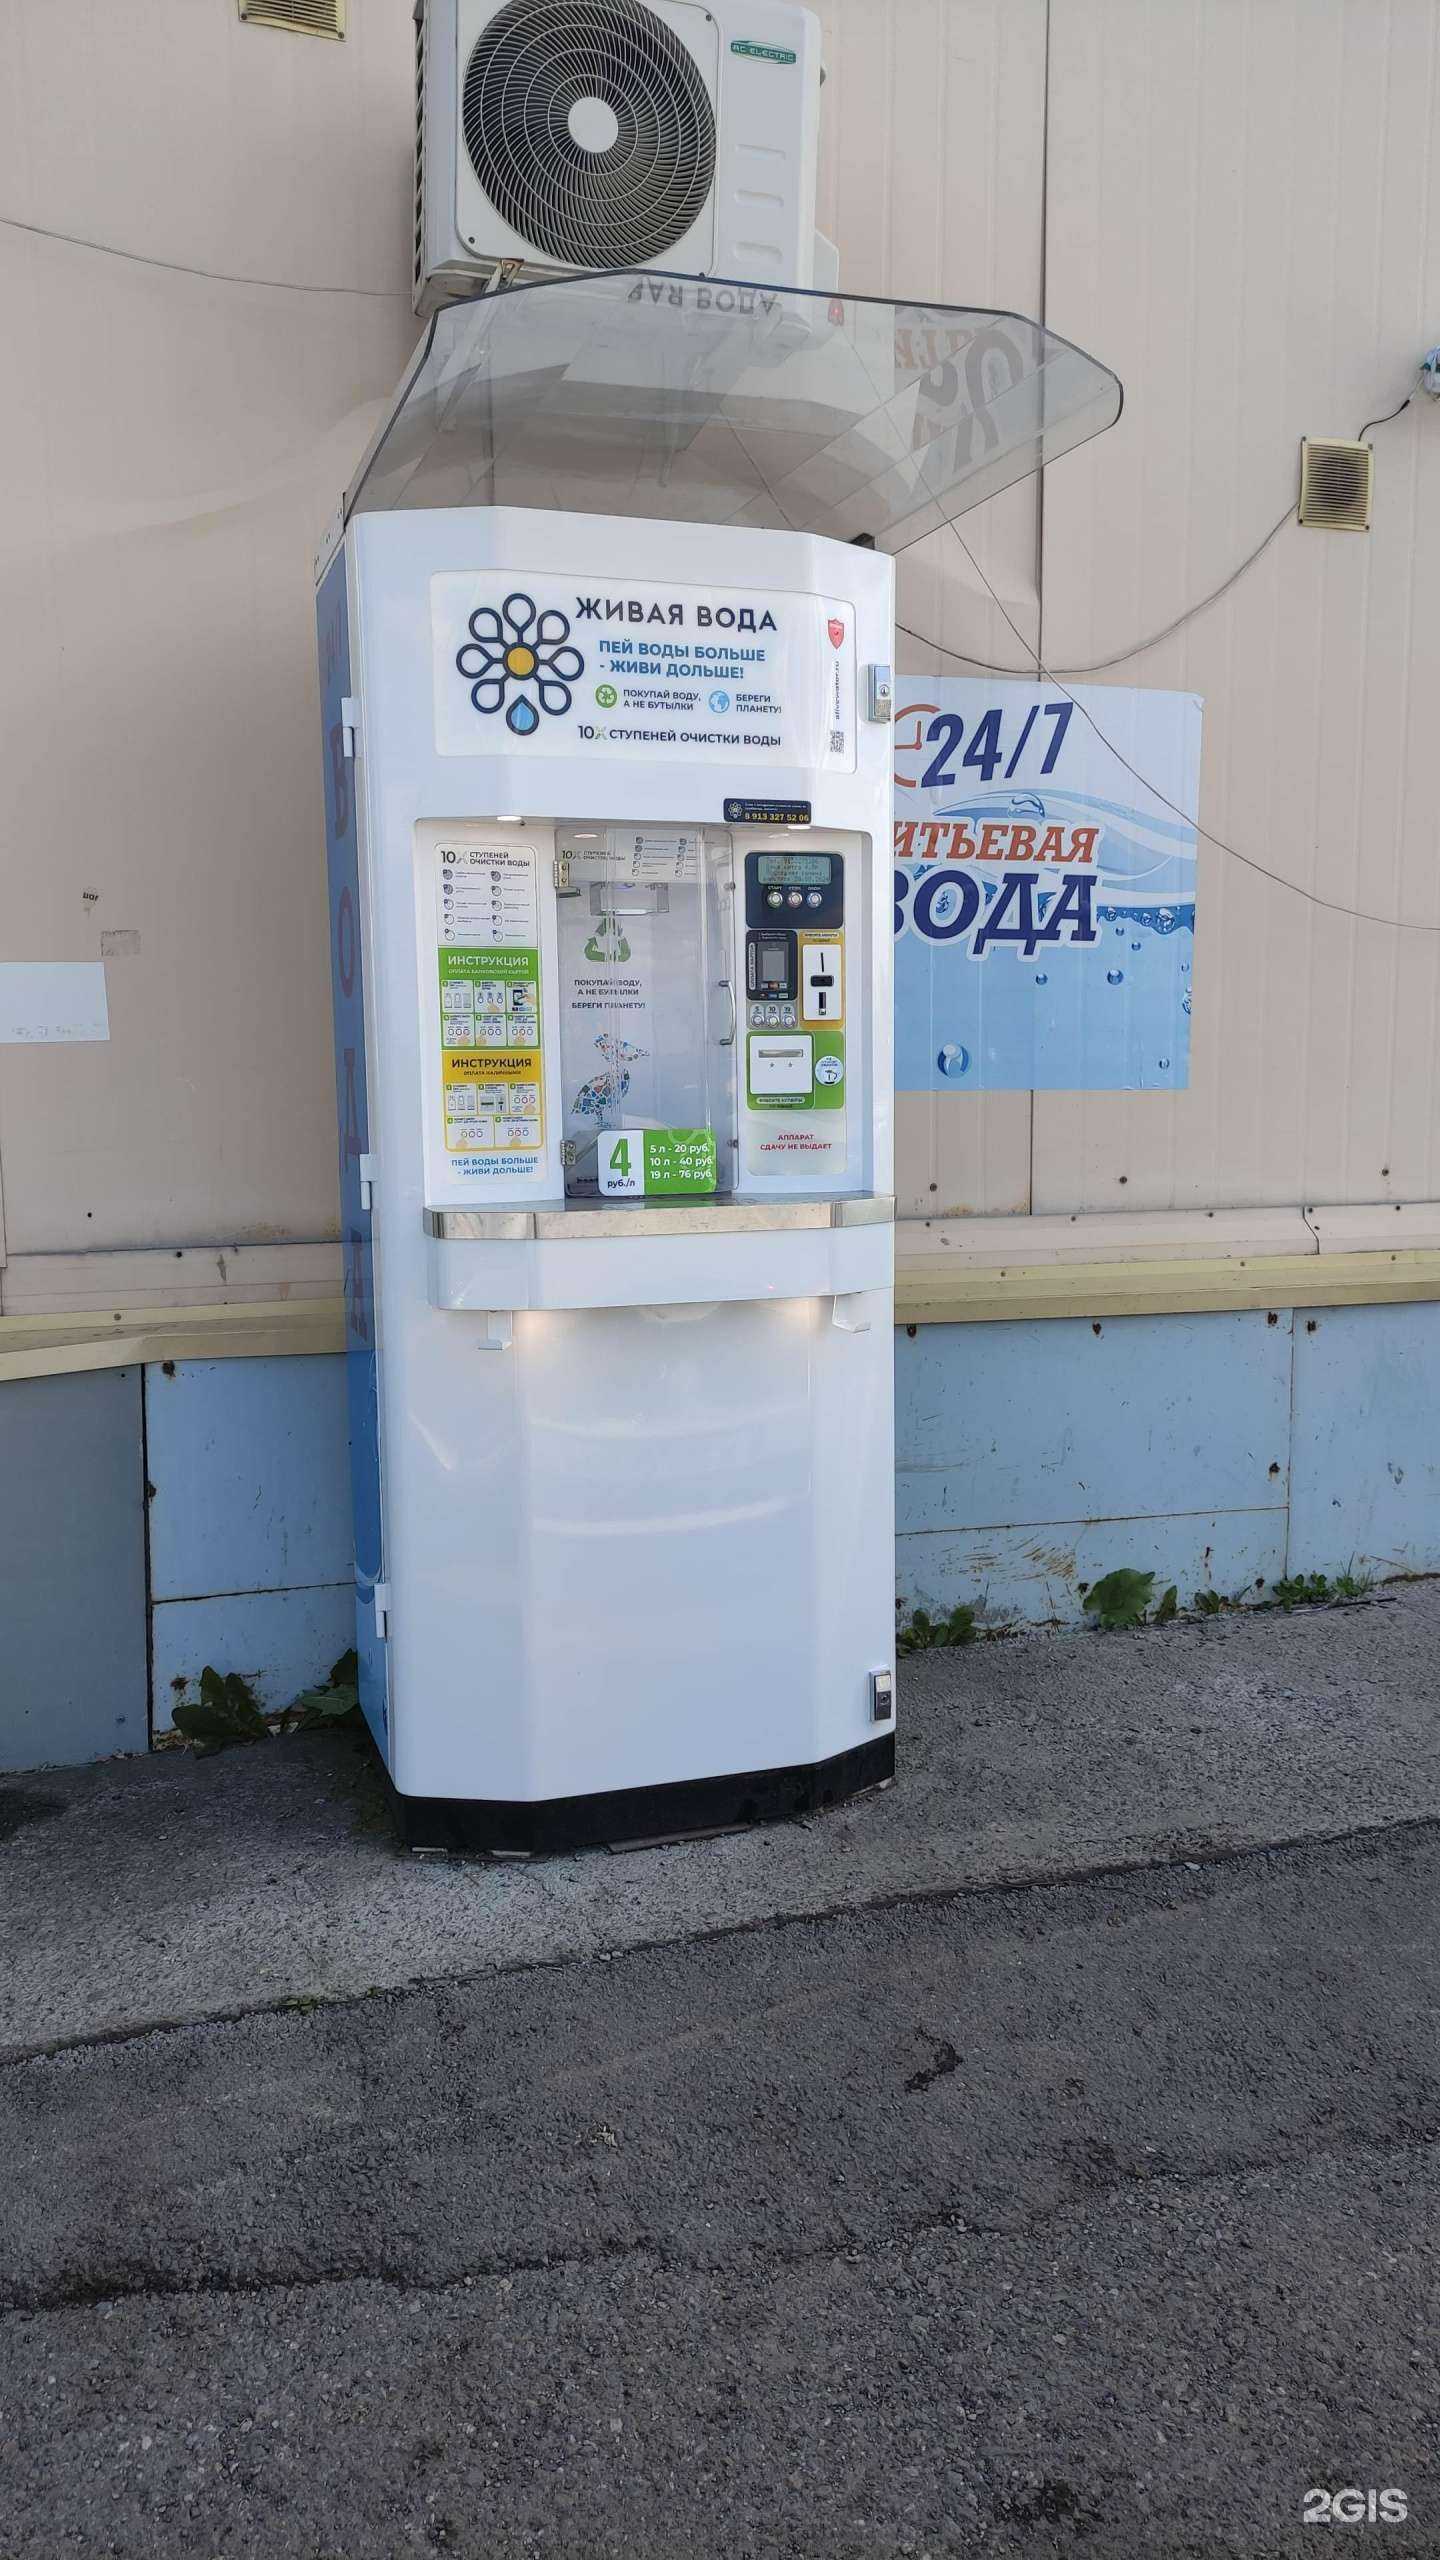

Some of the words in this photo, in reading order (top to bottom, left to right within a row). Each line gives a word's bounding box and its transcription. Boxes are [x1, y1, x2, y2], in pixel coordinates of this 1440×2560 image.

[732, 44, 747, 53] AC
[750, 48, 794, 61] ELECTRIC
[576, 597, 683, 626] ЖИВАЯ
[697, 605, 778, 634] ВОДА
[599, 639, 633, 655] ПЕЙ
[639, 643, 689, 659] ВОДЫ
[694, 647, 766, 662] БОЛЬШЕ
[610, 660, 661, 674] ЖИВИ
[666, 664, 744, 679] ДОЛЬШЕ!
[623, 689, 670, 699] ПОКУПАЙ
[673, 692, 701, 702] ВОДУ,
[736, 694, 771, 703] БЕРЕГИ
[623, 701, 631, 709] А
[633, 701, 645, 709] НЕ
[648, 702, 694, 711] БУТЫЛКИ
[736, 705, 782, 714] ПЛАНЕТУ!
[609, 729, 677, 742] СТУПЕНЕЙ
[680, 732, 740, 744] ОЧИСТКИ
[743, 735, 781, 746] ВОДЫ
[921, 702, 1073, 788] 24/7
[770, 813, 784, 821] 327
[469, 851, 509, 859] СТУПЕНЕЙ
[469, 858, 506, 866] ОЧИСТКИ
[508, 860, 530, 868] ВОДЫ
[448, 955, 529, 967] ИНСТРУКЦИЯ
[452, 1059, 532, 1068] ИНСТРУКЦИЯ
[650, 1145, 657, 1153] 5
[674, 1144, 687, 1153] 20
[760, 1143, 786, 1151] СДАЧУ
[452, 1157, 469, 1167] ПЕЙ
[472, 1157, 499, 1167] ВОДЫ
[501, 1156, 539, 1166] БОЛЬШЕ
[610, 1138, 632, 1177] 4
[650, 1157, 661, 1166] 10
[679, 1157, 693, 1166] 40
[463, 1167, 491, 1176] ЖИВИ
[492, 1165, 534, 1175] ДОЛЬШЕ!
[650, 1170, 661, 1179] 19
[678, 1169, 692, 1178] 76
[607, 1179, 636, 1188] руб./л
